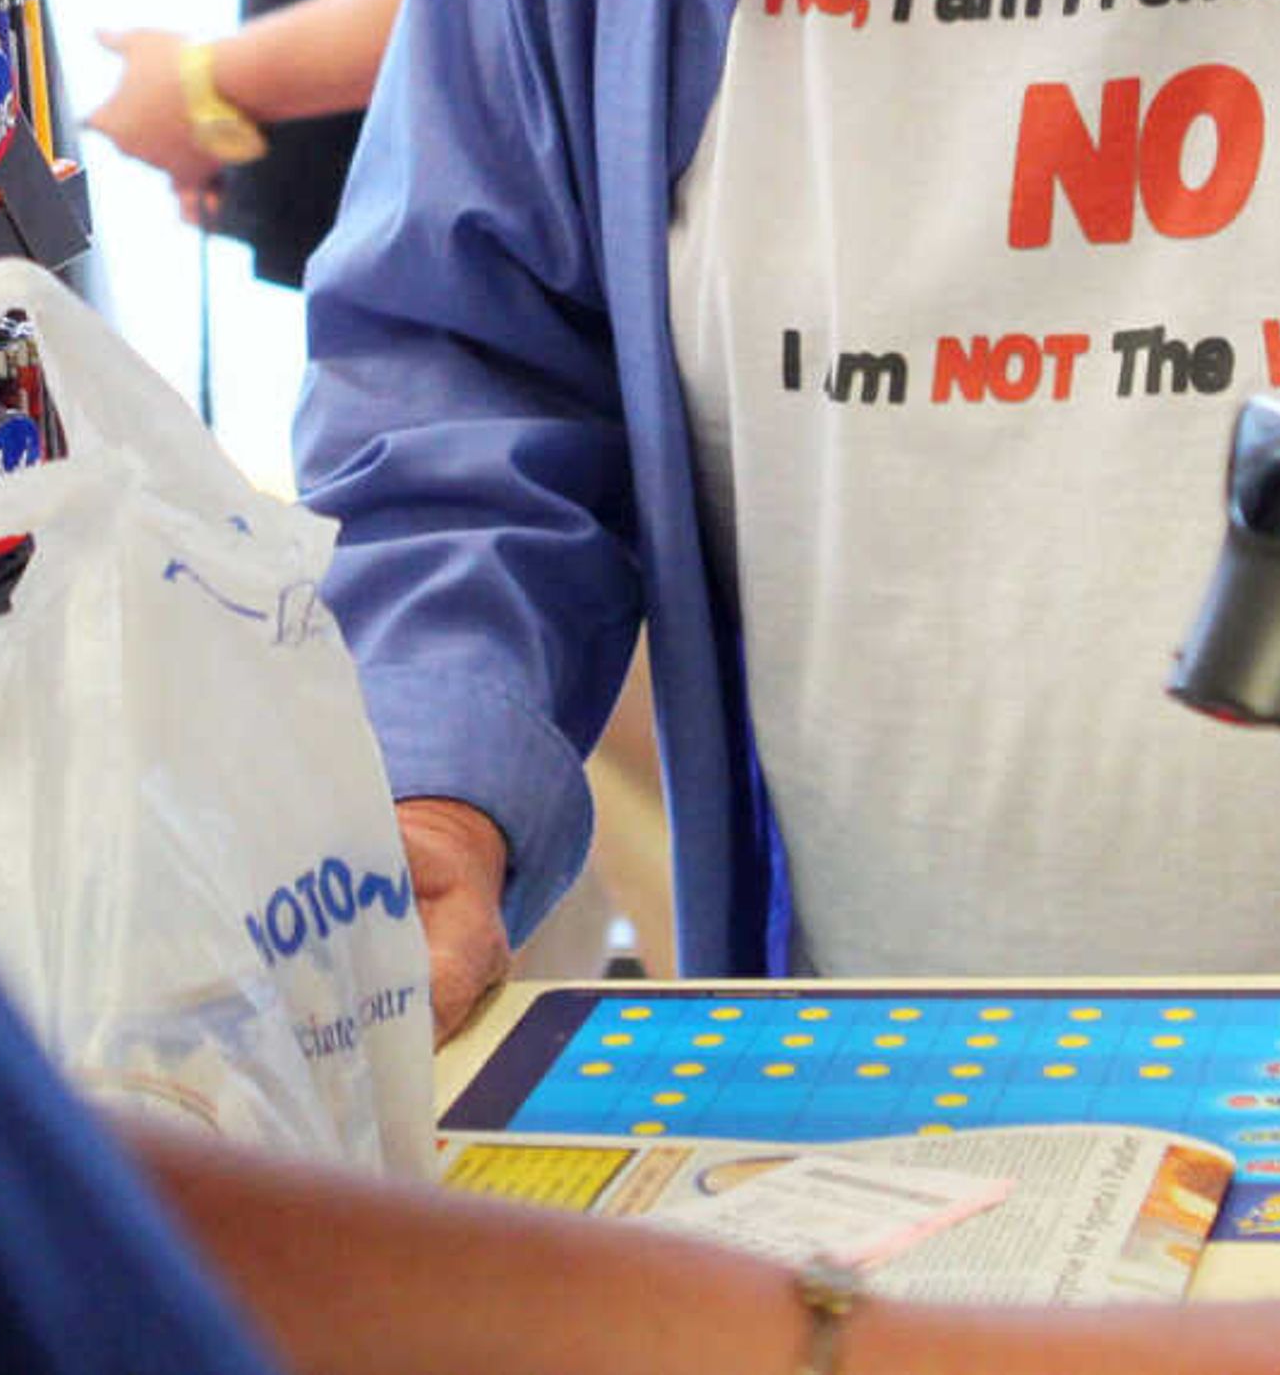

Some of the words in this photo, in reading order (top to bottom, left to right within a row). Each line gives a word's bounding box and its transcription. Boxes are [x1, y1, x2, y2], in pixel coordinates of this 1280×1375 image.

[1007, 63, 1265, 249] NO
[782, 328, 802, 392] I
[823, 351, 908, 404] m
[931, 332, 1090, 404] NOT
[1113, 325, 1235, 399] The
